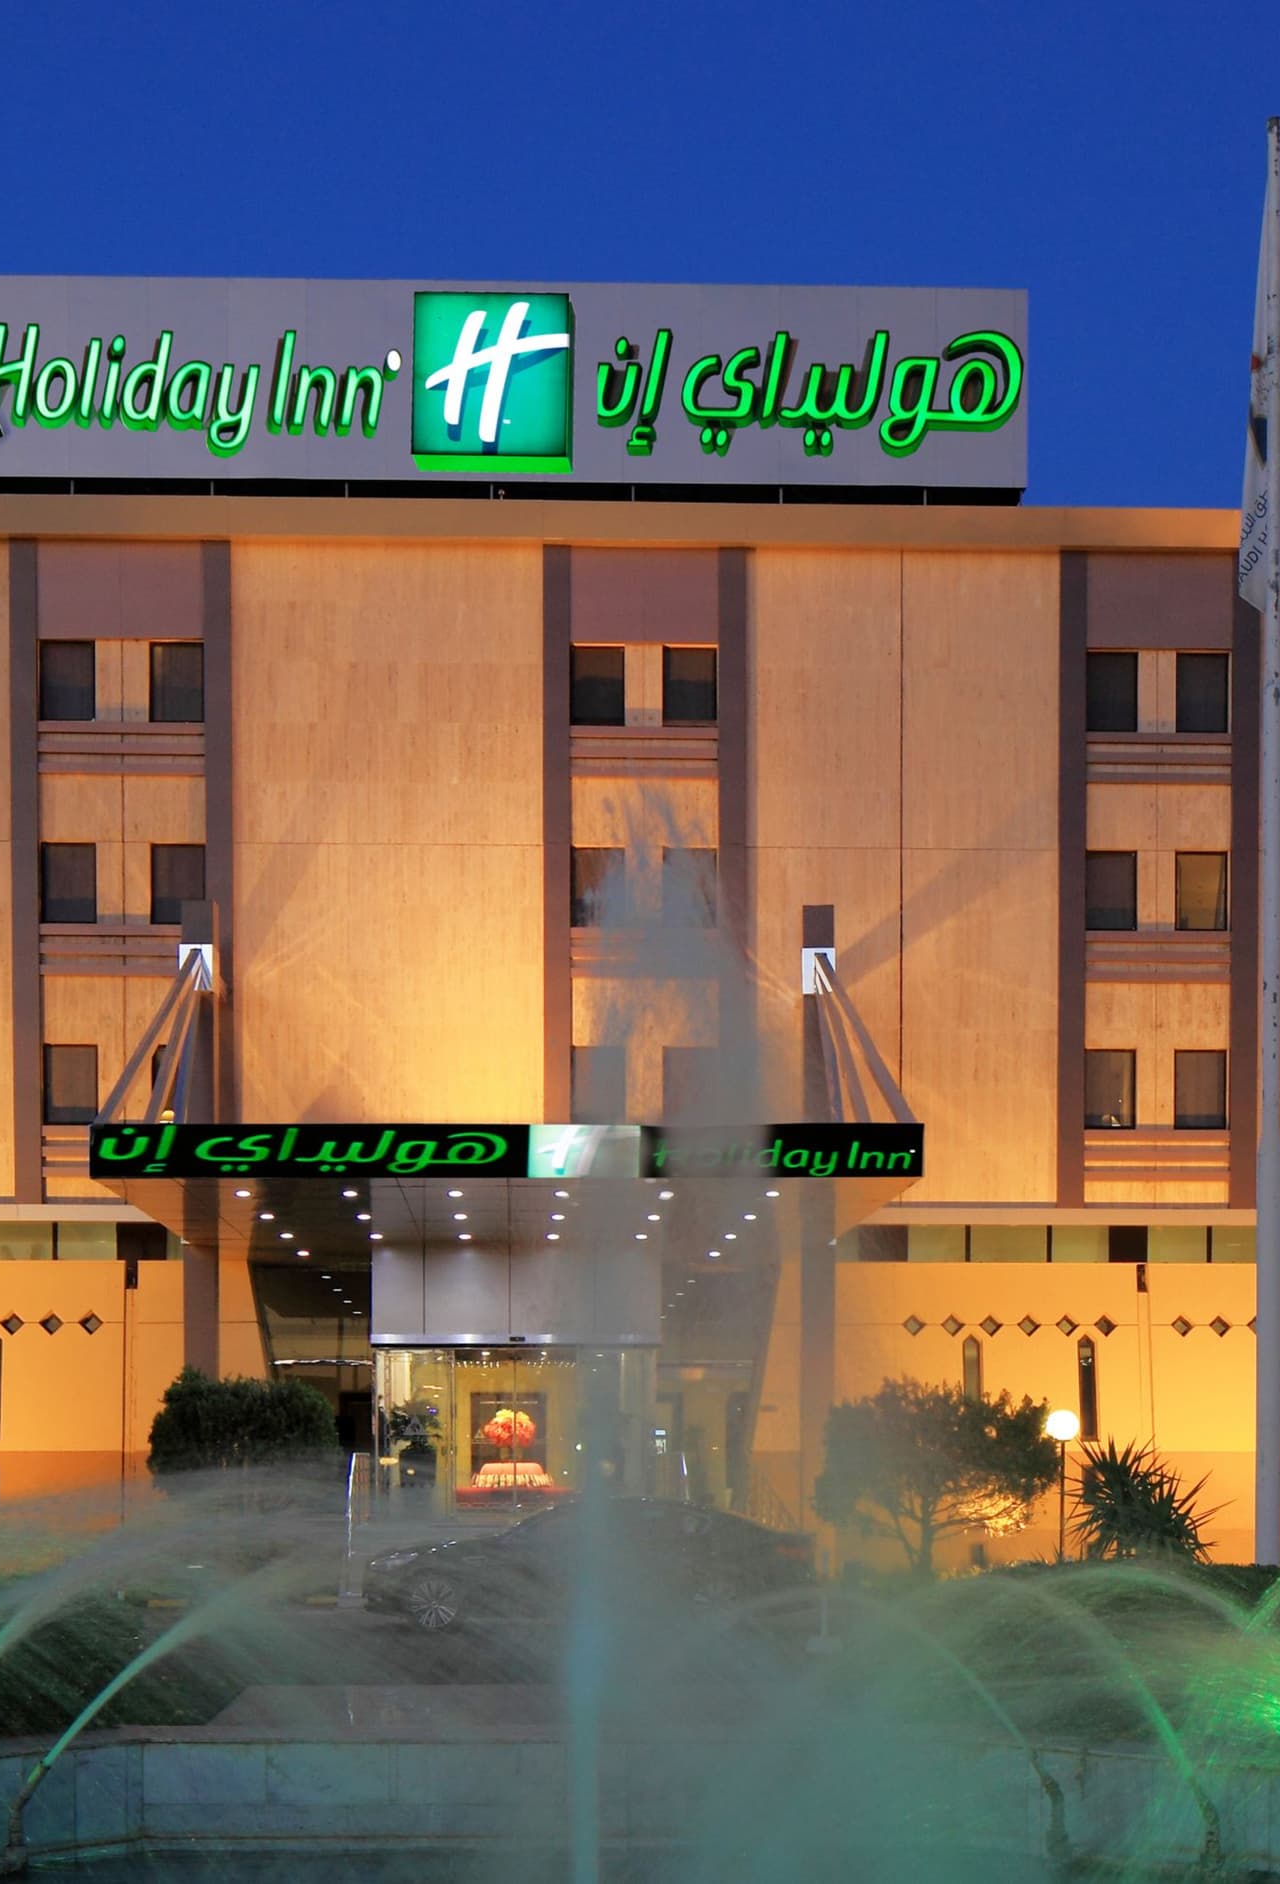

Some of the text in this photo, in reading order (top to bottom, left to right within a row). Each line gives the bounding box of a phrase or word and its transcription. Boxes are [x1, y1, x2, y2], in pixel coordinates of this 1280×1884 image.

[267, 329, 384, 438] Inn
[597, 328, 1023, 457] هوليداي إن
[99, 1125, 508, 1174] هوليداي إن
[846, 1140, 912, 1170] Inn
